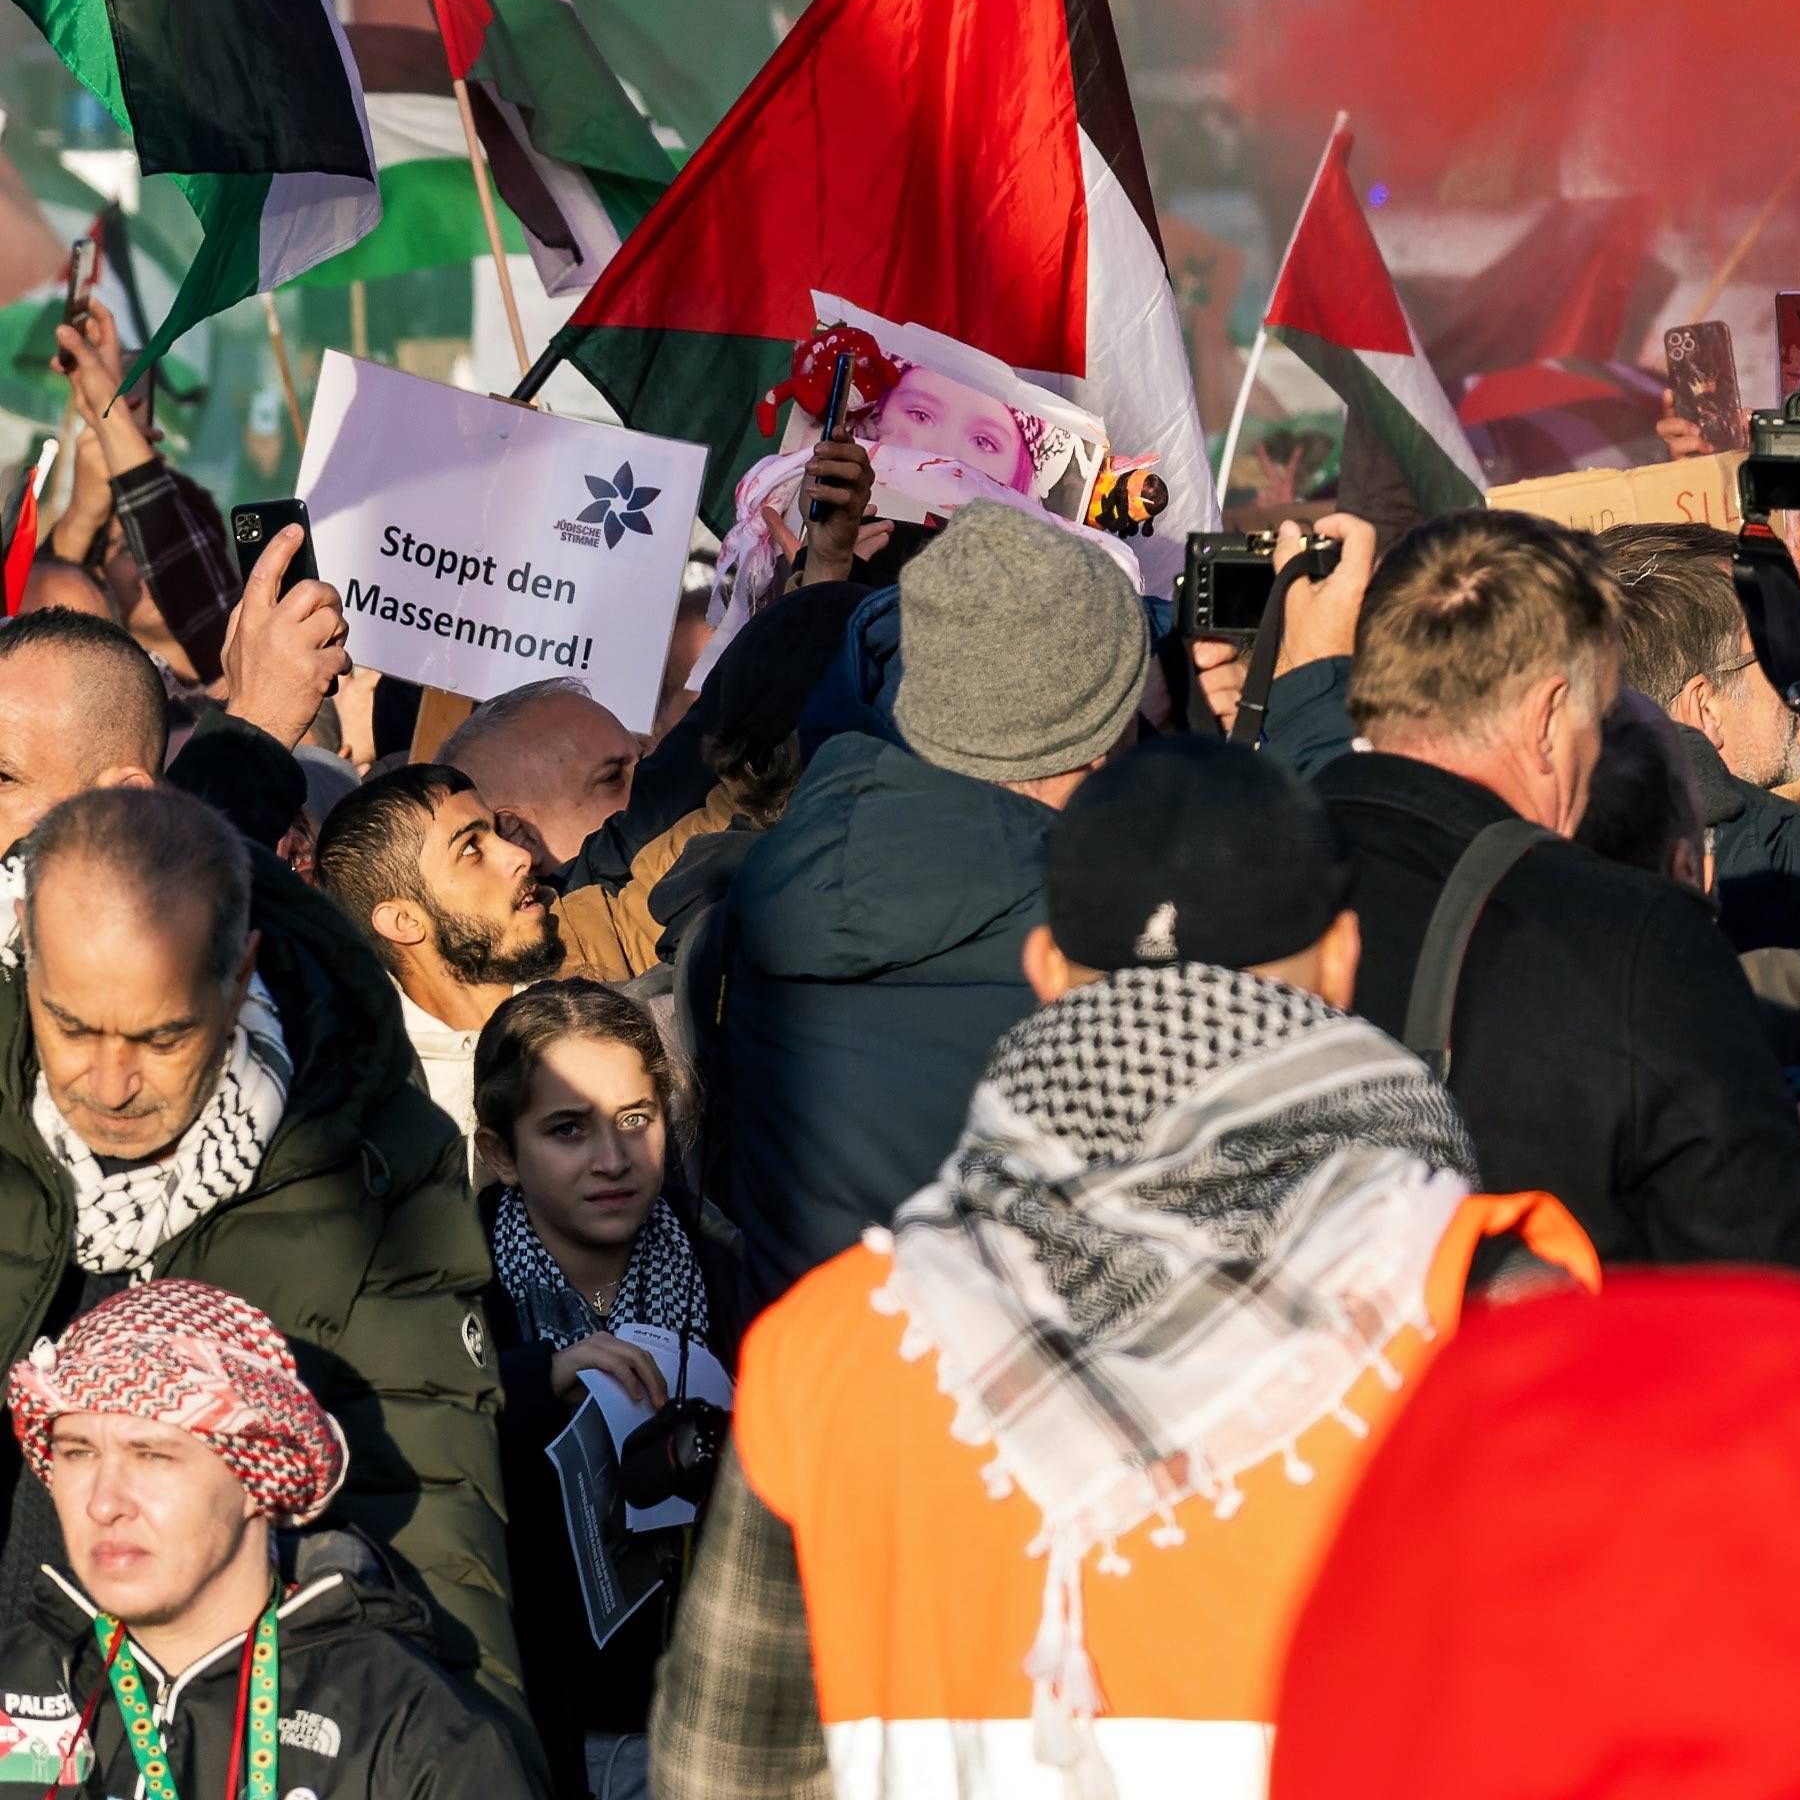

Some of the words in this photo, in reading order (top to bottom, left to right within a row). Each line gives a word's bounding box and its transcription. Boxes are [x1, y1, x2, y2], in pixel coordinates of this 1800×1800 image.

[380, 525, 497, 587] Stoppt
[507, 562, 577, 604] den
[560, 531, 600, 548] STIMME
[344, 578, 594, 670] Massenmord!
